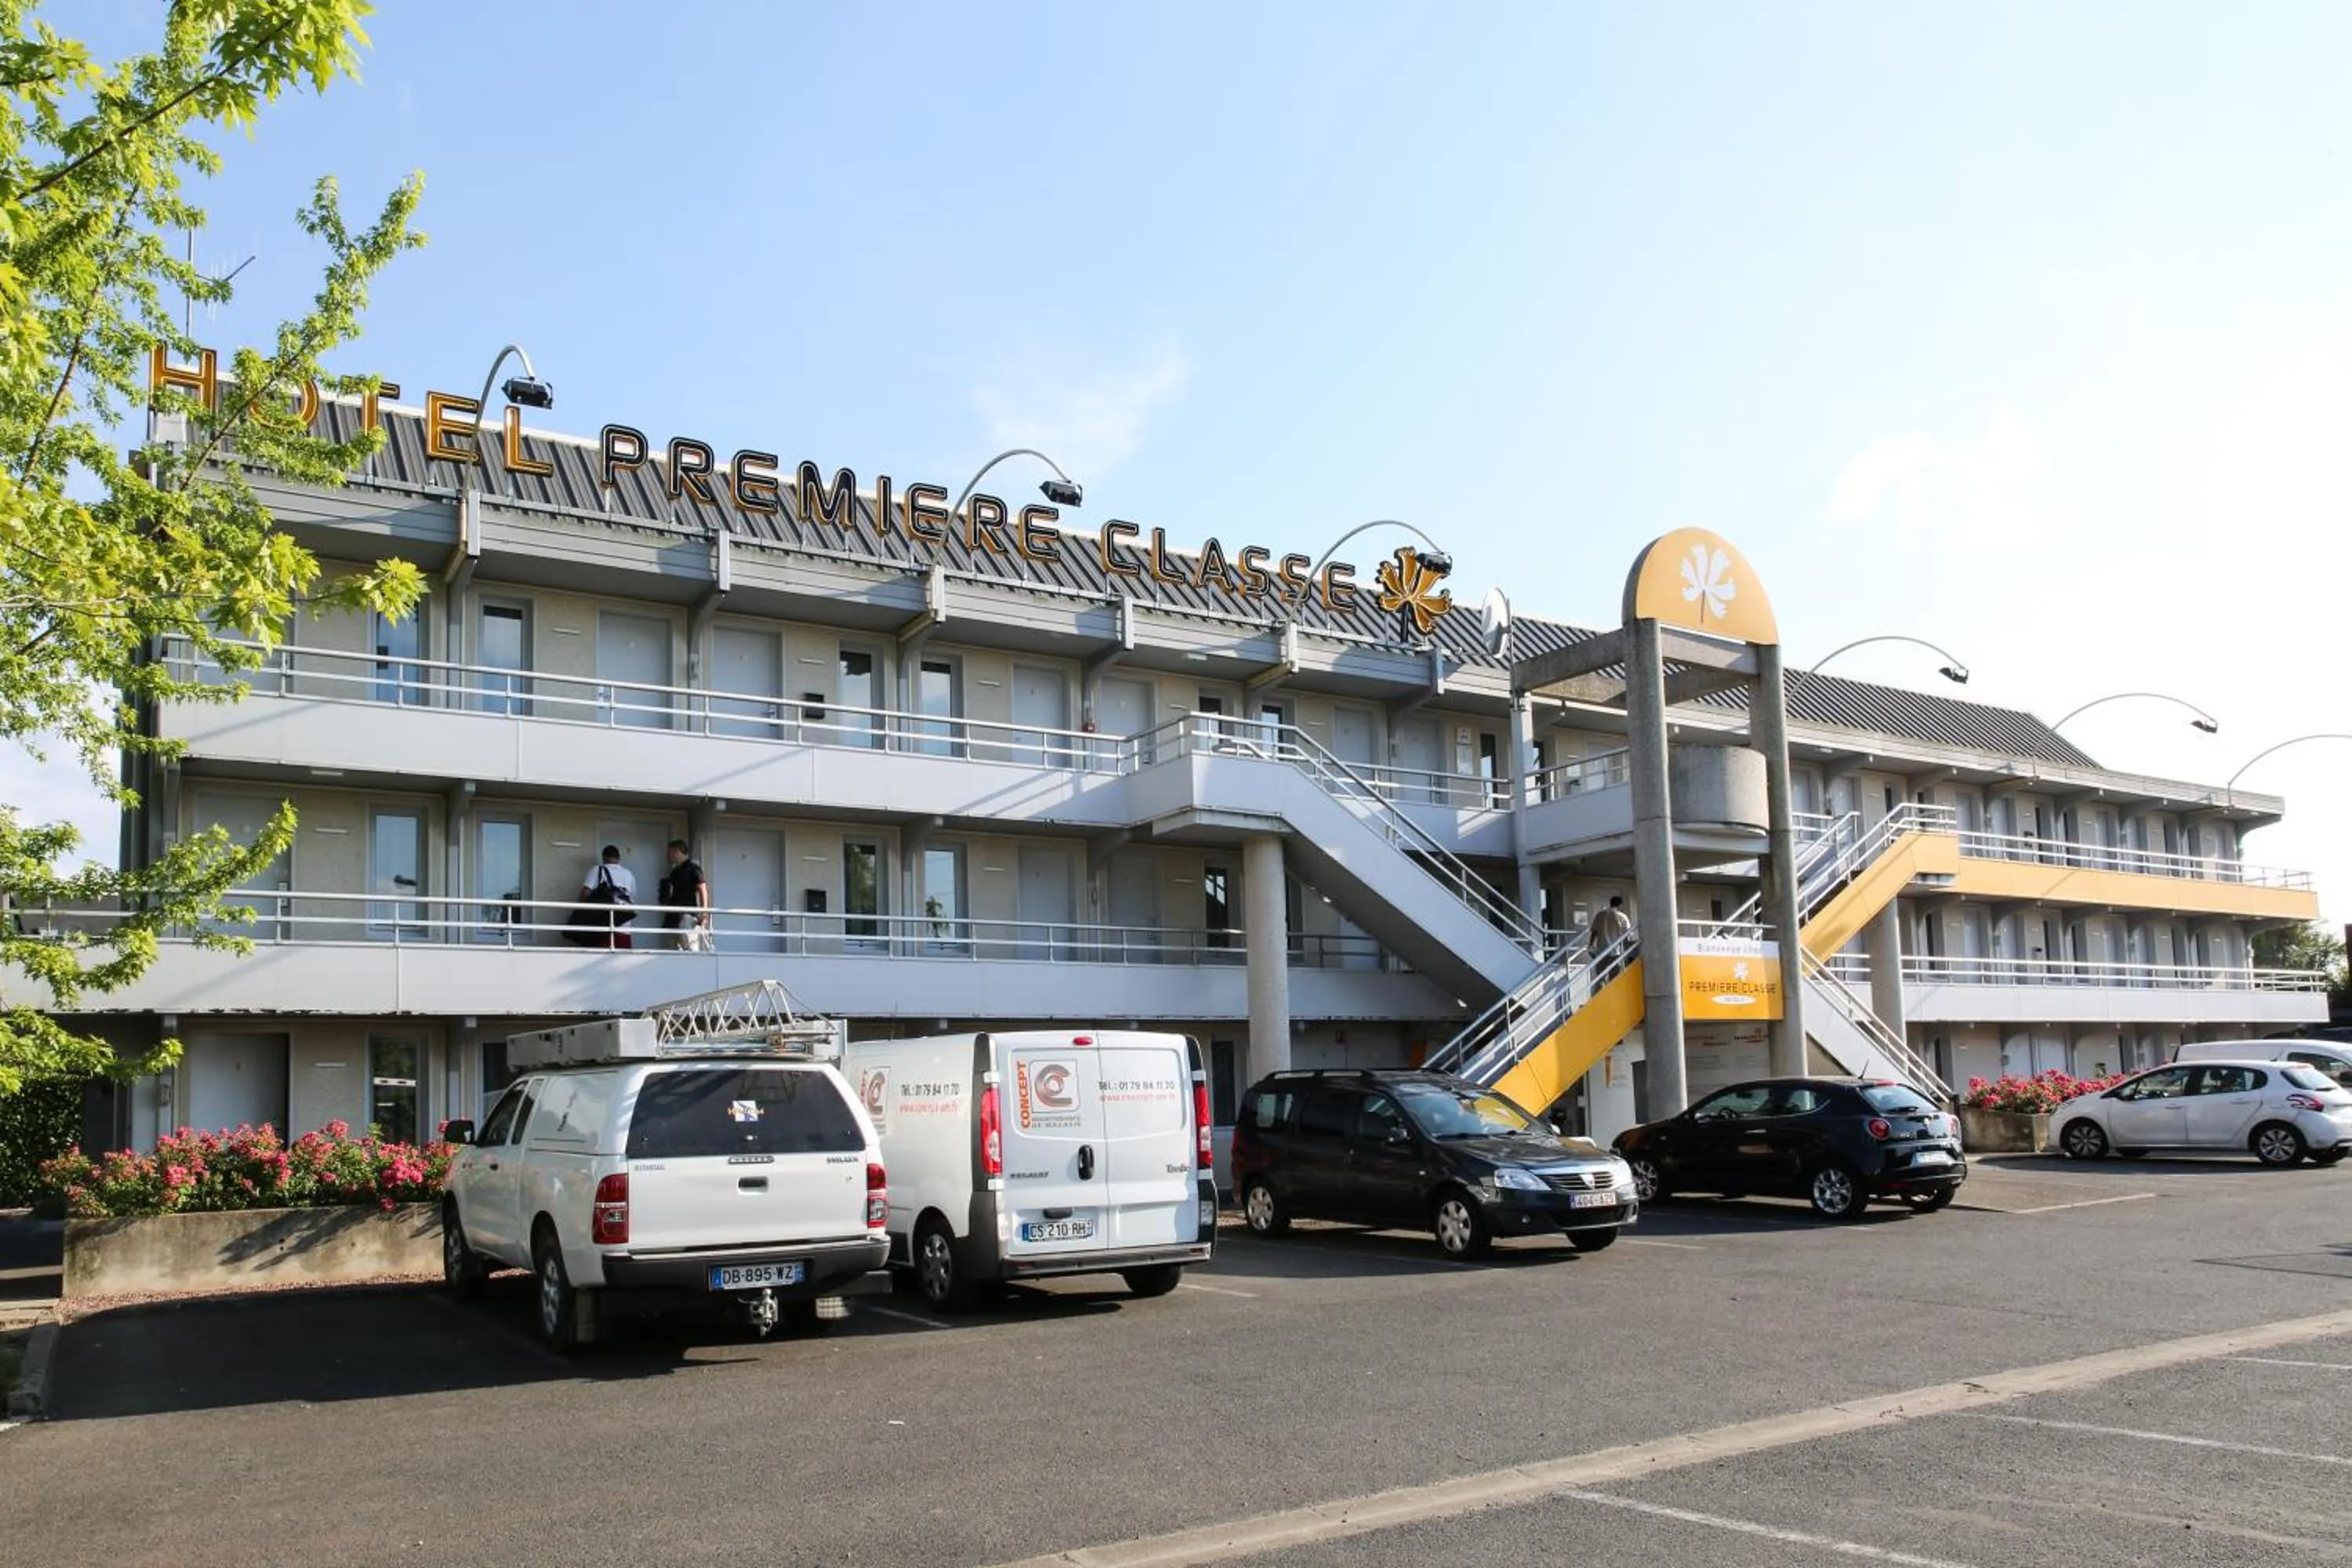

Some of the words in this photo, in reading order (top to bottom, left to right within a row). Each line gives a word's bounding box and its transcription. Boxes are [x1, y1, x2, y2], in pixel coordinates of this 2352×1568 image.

[149, 339, 554, 476] HOTEL
[601, 423, 1061, 562] PREMIERE
[1101, 518, 1357, 614] CLASSE
[1017, 1059, 1031, 1129] CONCEPT
